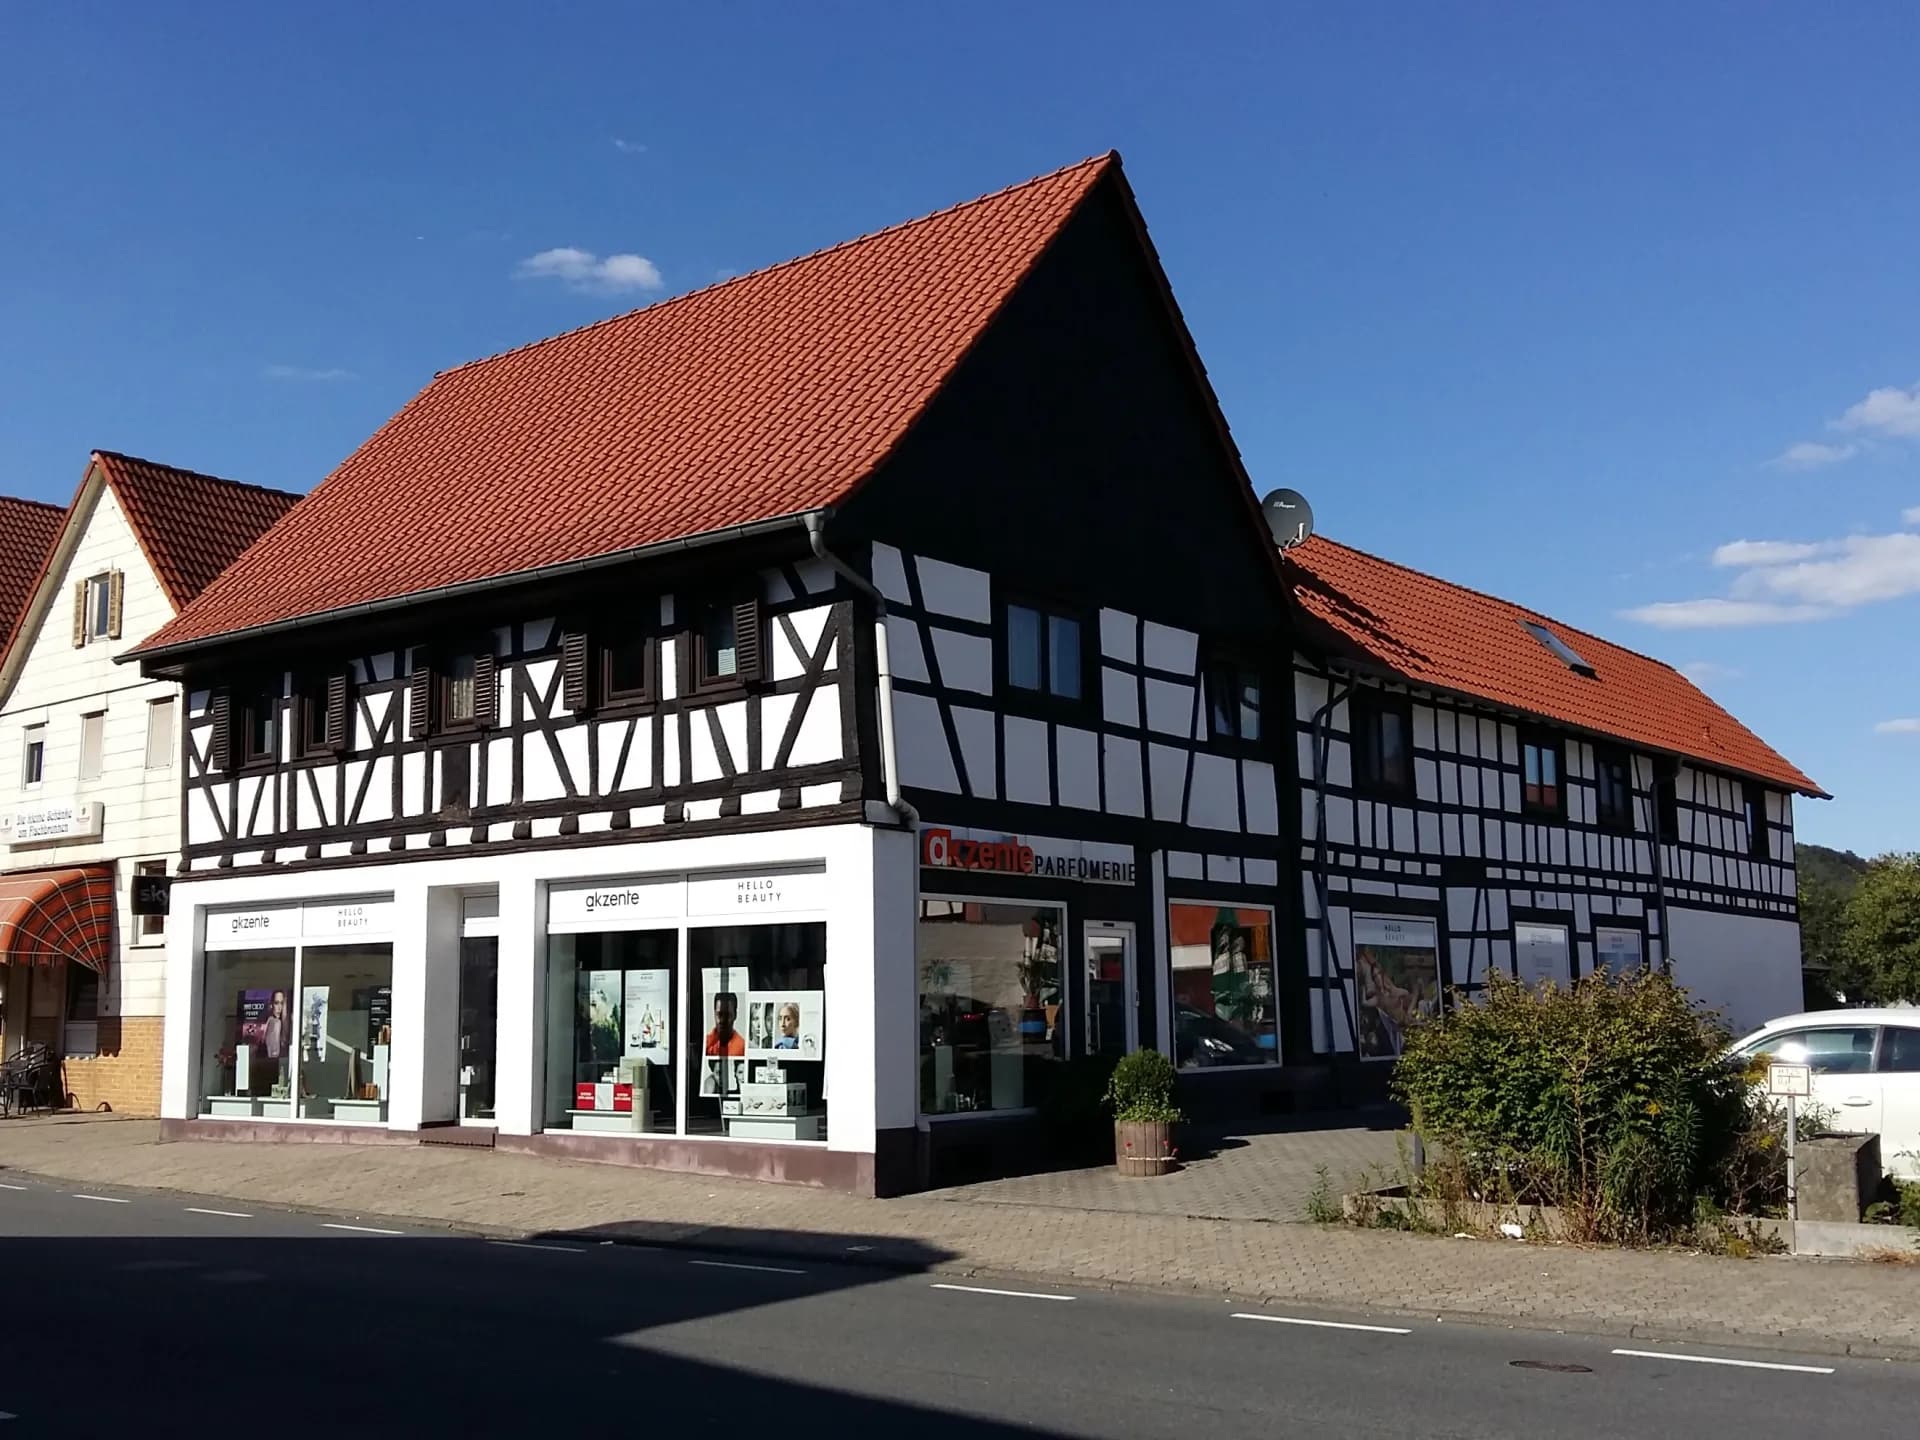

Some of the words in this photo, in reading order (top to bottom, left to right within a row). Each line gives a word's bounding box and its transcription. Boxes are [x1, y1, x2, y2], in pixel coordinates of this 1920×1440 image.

[923, 828, 1034, 874] akzente
[738, 879, 774, 891] HELLO
[140, 884, 169, 907] sky
[586, 889, 639, 911] akzente
[738, 892, 782, 904] BEAUTY
[338, 907, 363, 917] HELLO
[231, 913, 269, 933] akzente
[338, 917, 368, 928] BEAUTY
